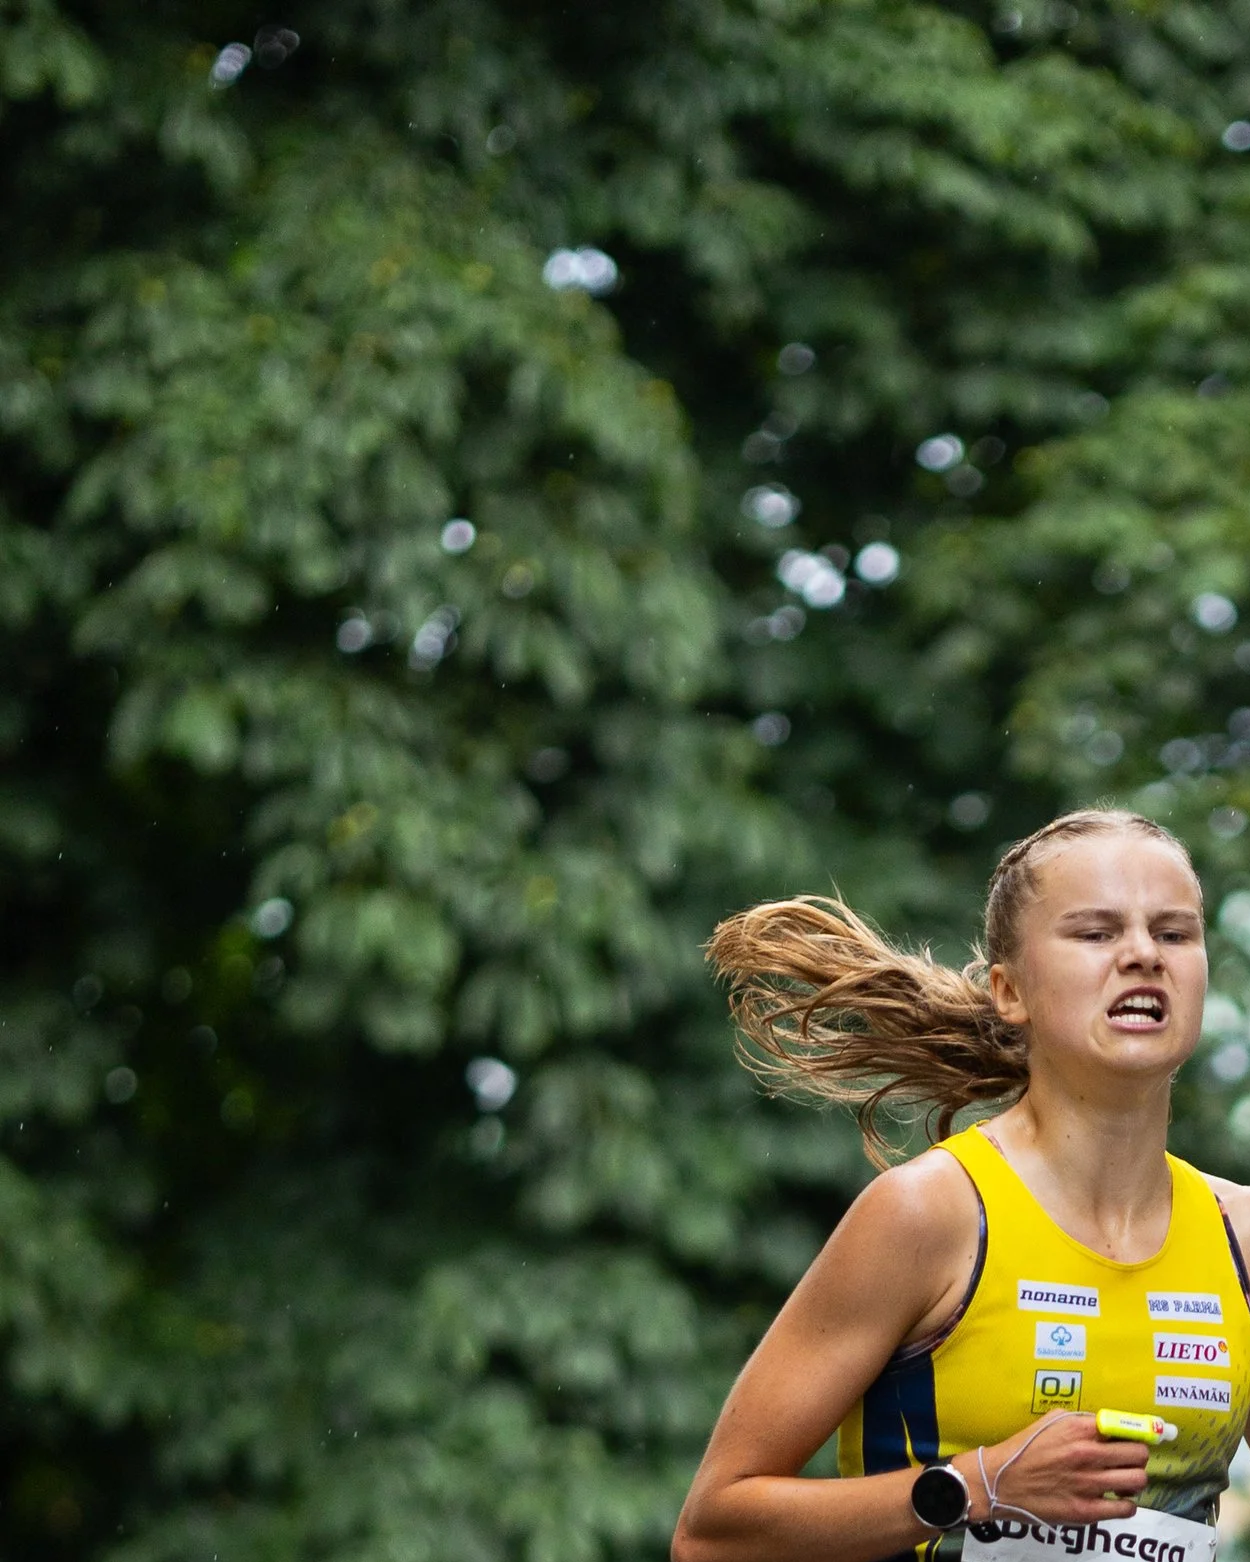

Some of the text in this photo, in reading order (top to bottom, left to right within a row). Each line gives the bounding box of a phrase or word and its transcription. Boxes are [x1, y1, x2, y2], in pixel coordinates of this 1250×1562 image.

[1020, 1289, 1098, 1307] noname
[1148, 1299, 1221, 1315] MS PARMA
[1156, 1340, 1217, 1362] LIETO
[1041, 1376, 1076, 1398] OJ
[1156, 1385, 1230, 1403] MYNÄMÄKI
